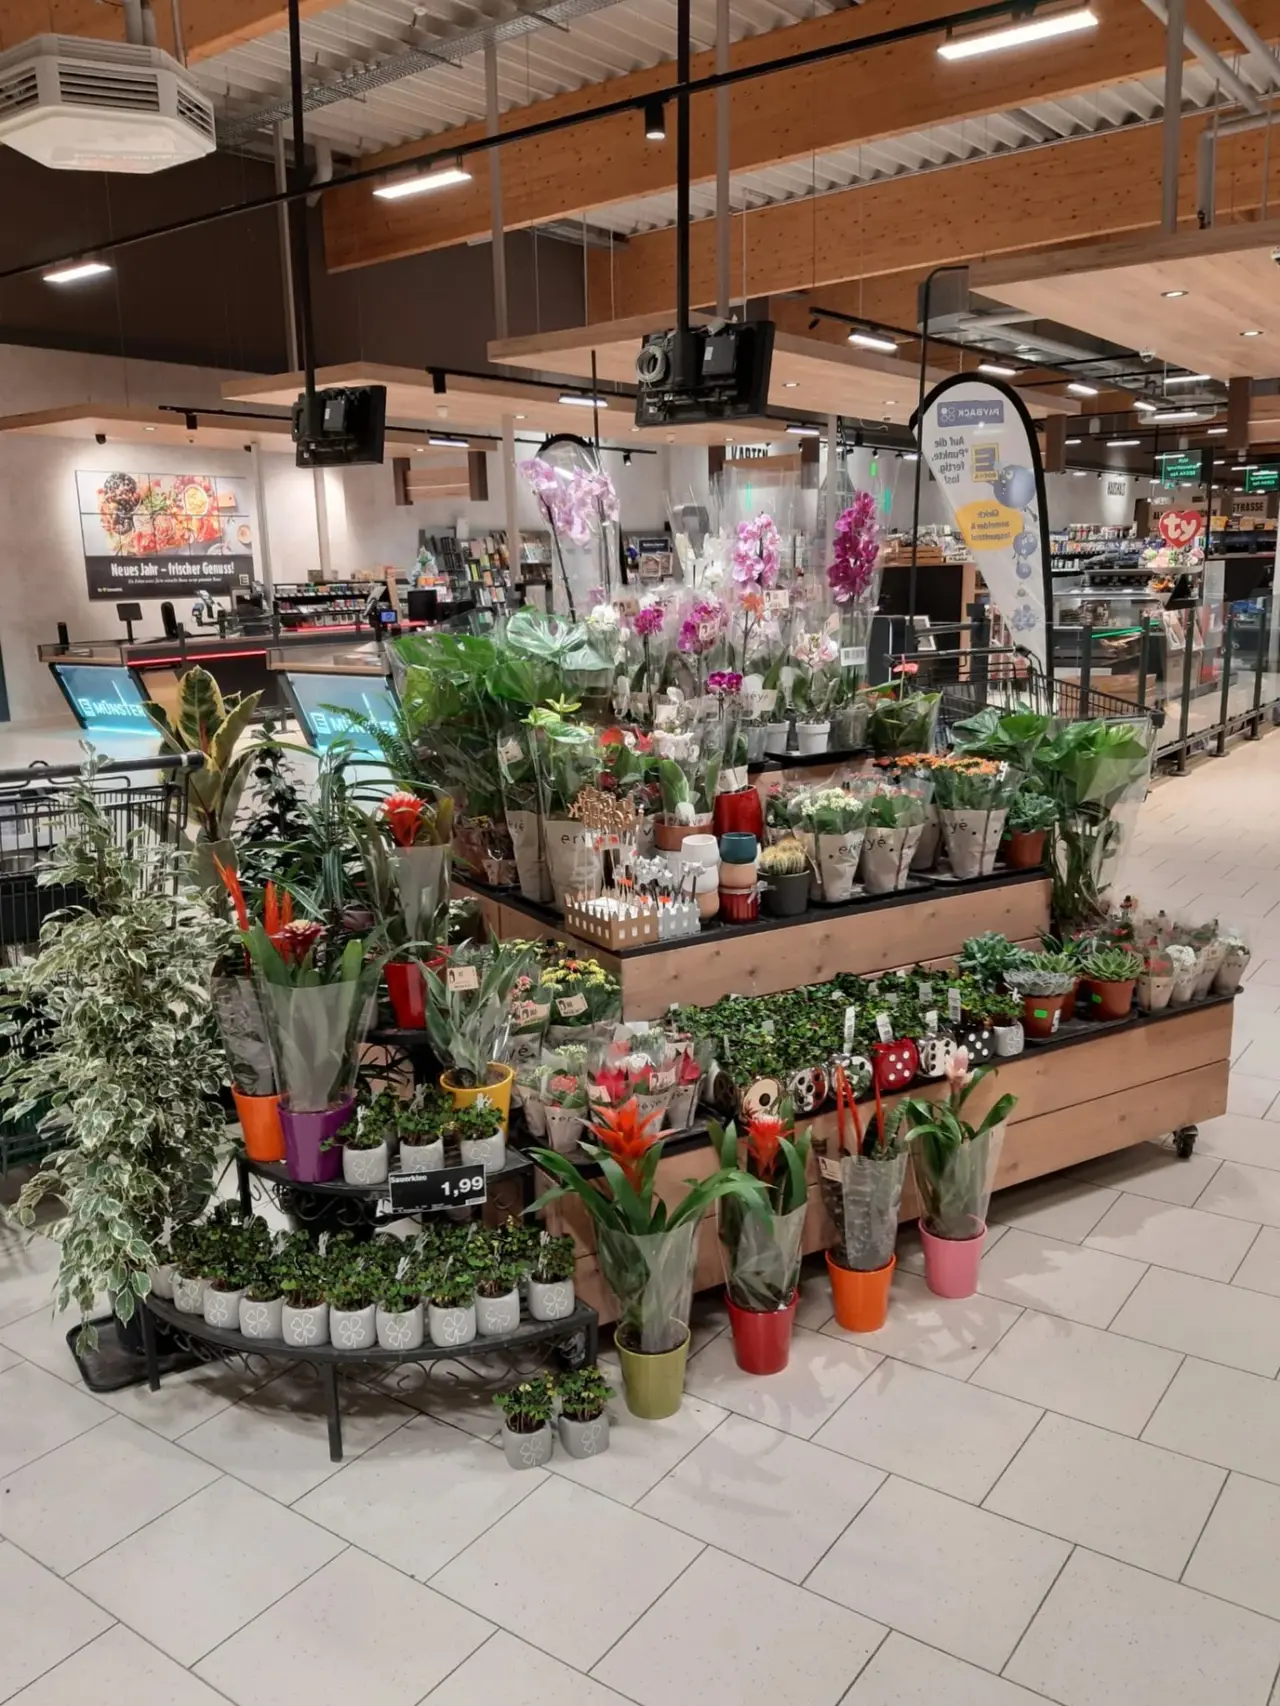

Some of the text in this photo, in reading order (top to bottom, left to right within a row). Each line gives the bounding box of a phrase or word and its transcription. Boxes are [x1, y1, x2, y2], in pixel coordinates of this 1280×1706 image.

[1163, 513, 1197, 542] ty
[110, 563, 139, 577] Neues
[140, 562, 158, 576] Jahr
[168, 562, 201, 575] frischer
[202, 561, 235, 575] Genuss!
[94, 701, 146, 717] MÜNSTER
[440, 1175, 484, 1198] 1,99
